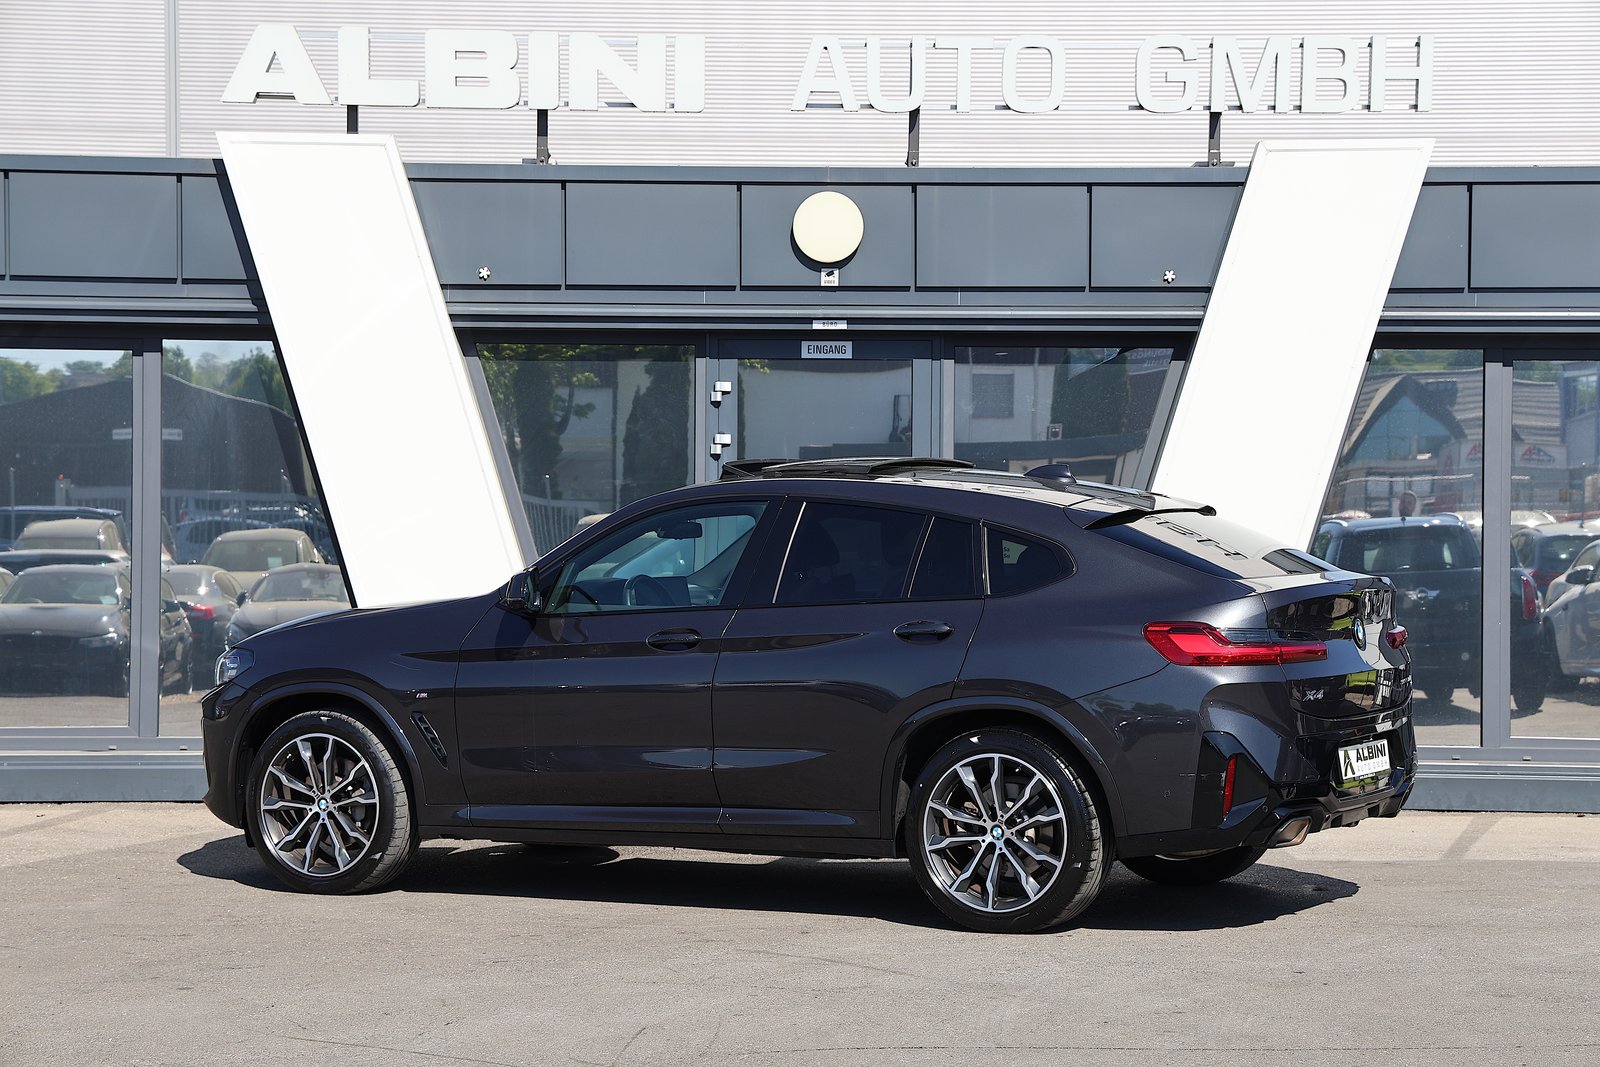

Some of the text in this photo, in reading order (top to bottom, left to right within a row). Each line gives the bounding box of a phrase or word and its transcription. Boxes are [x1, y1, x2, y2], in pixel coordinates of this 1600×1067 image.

[221, 24, 1434, 114] ALBINI AUTO GMBH
[807, 344, 847, 355] EINGANG
[1303, 689, 1324, 701] X4
[1356, 742, 1386, 763] ALBINI
